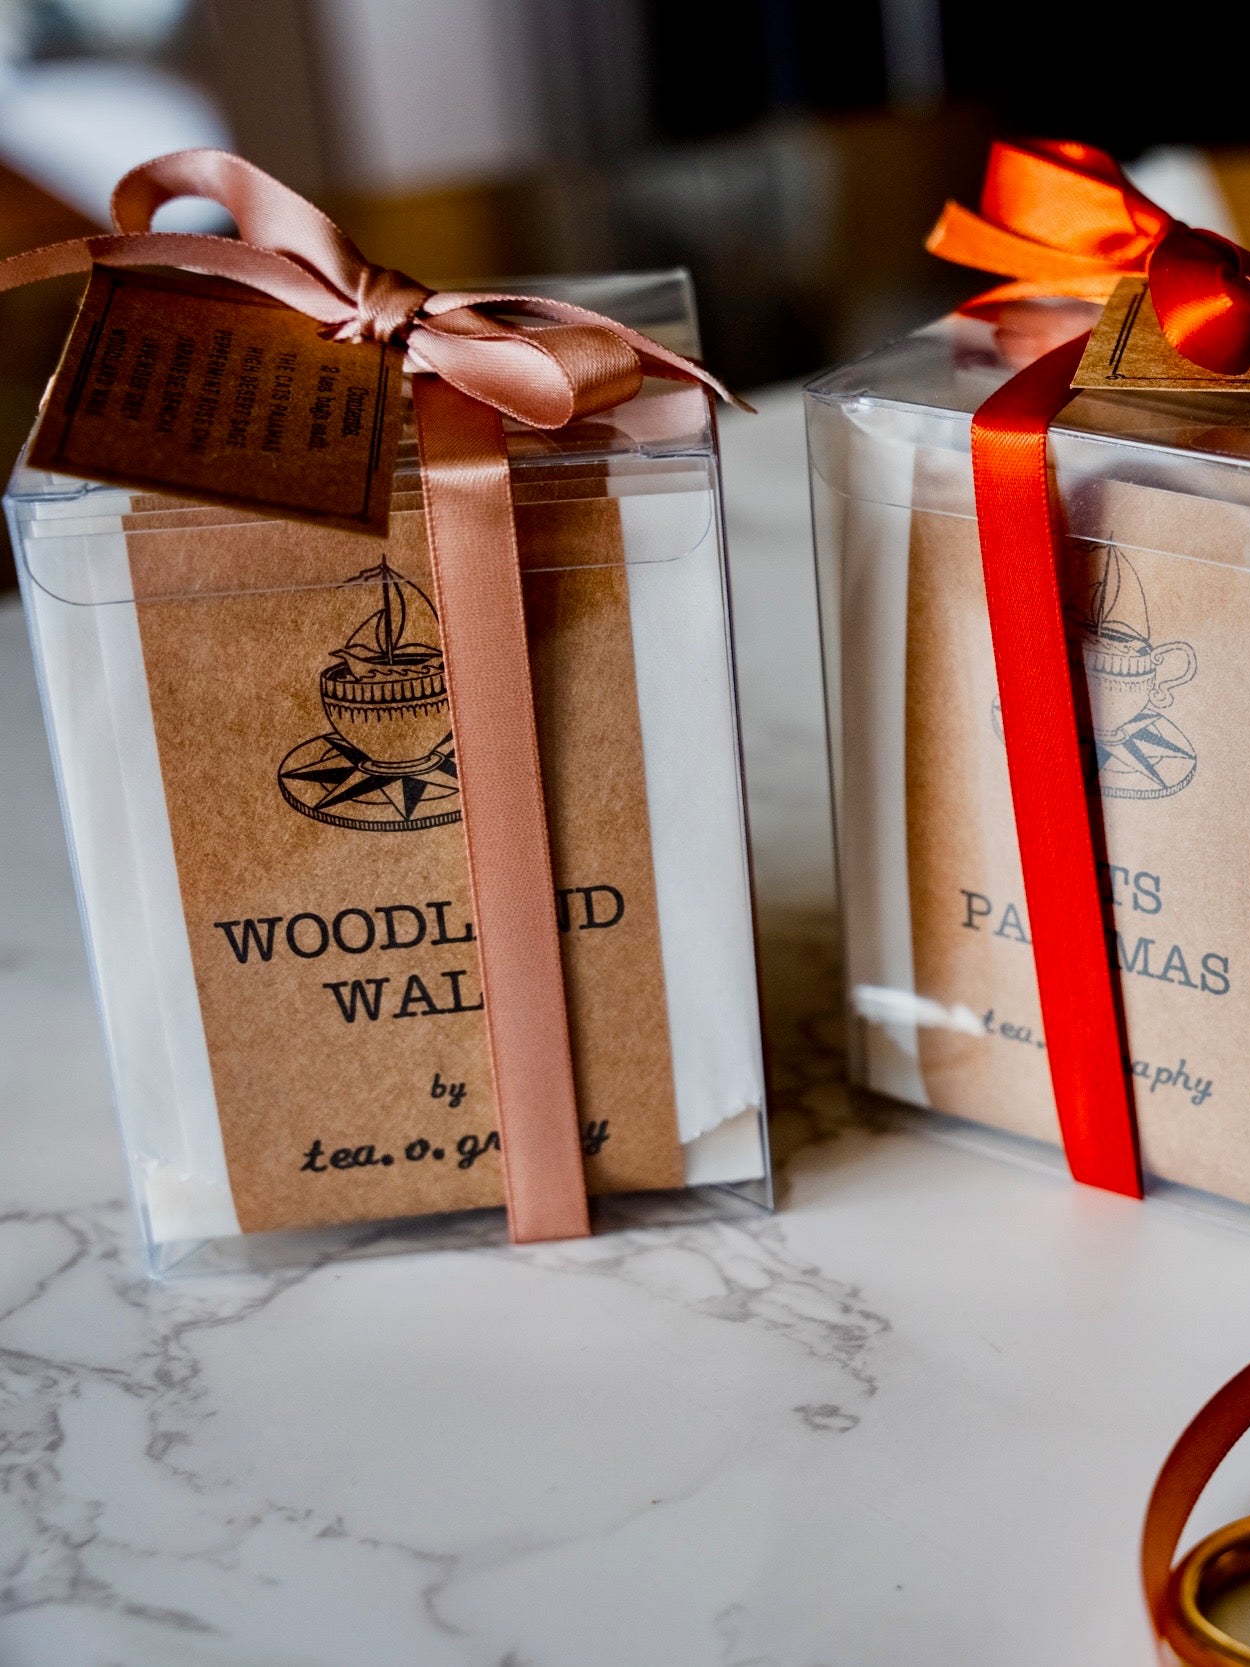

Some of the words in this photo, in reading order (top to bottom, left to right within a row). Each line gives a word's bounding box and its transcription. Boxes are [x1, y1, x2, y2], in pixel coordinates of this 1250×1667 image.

[242, 345, 265, 373] HIGH
[276, 351, 298, 373] THE
[320, 364, 341, 375] 2
[232, 374, 260, 417] DESERT
[270, 374, 294, 403] CATS
[310, 396, 335, 421] bags
[225, 417, 251, 449] SAGE
[213, 885, 626, 964] WOODLND
[960, 889, 1231, 996] PAMAS
[430, 1073, 467, 1108] by
